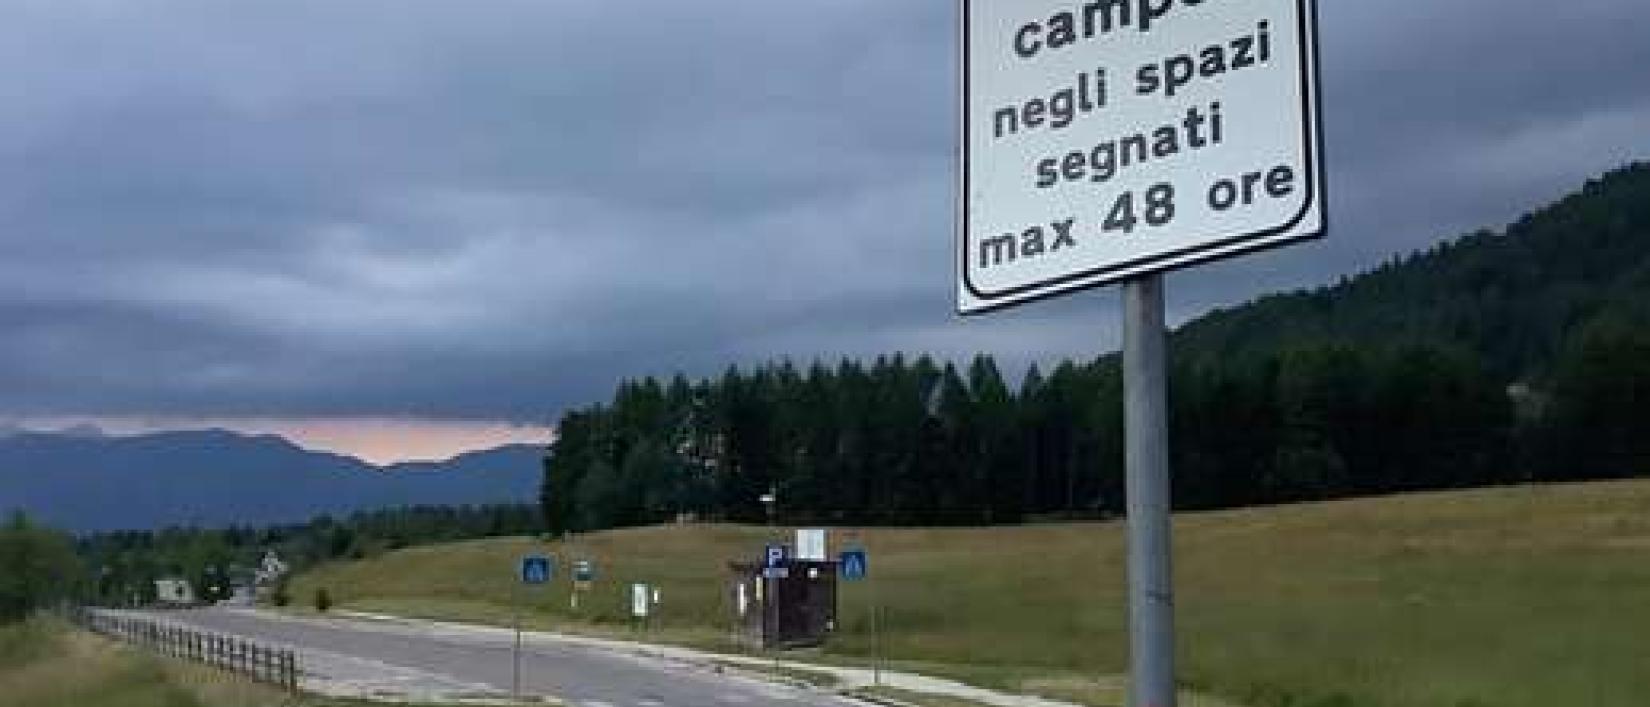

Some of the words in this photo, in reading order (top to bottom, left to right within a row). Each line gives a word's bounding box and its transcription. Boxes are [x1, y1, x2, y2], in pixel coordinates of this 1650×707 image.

[1014, 0, 1206, 57] camp
[994, 68, 1106, 137] negli
[1136, 19, 1271, 96] spazi
[1036, 101, 1223, 188] segnati
[979, 217, 1077, 268] max
[1102, 182, 1175, 234] 48
[1208, 165, 1294, 211] ore
[769, 548, 782, 566] P
